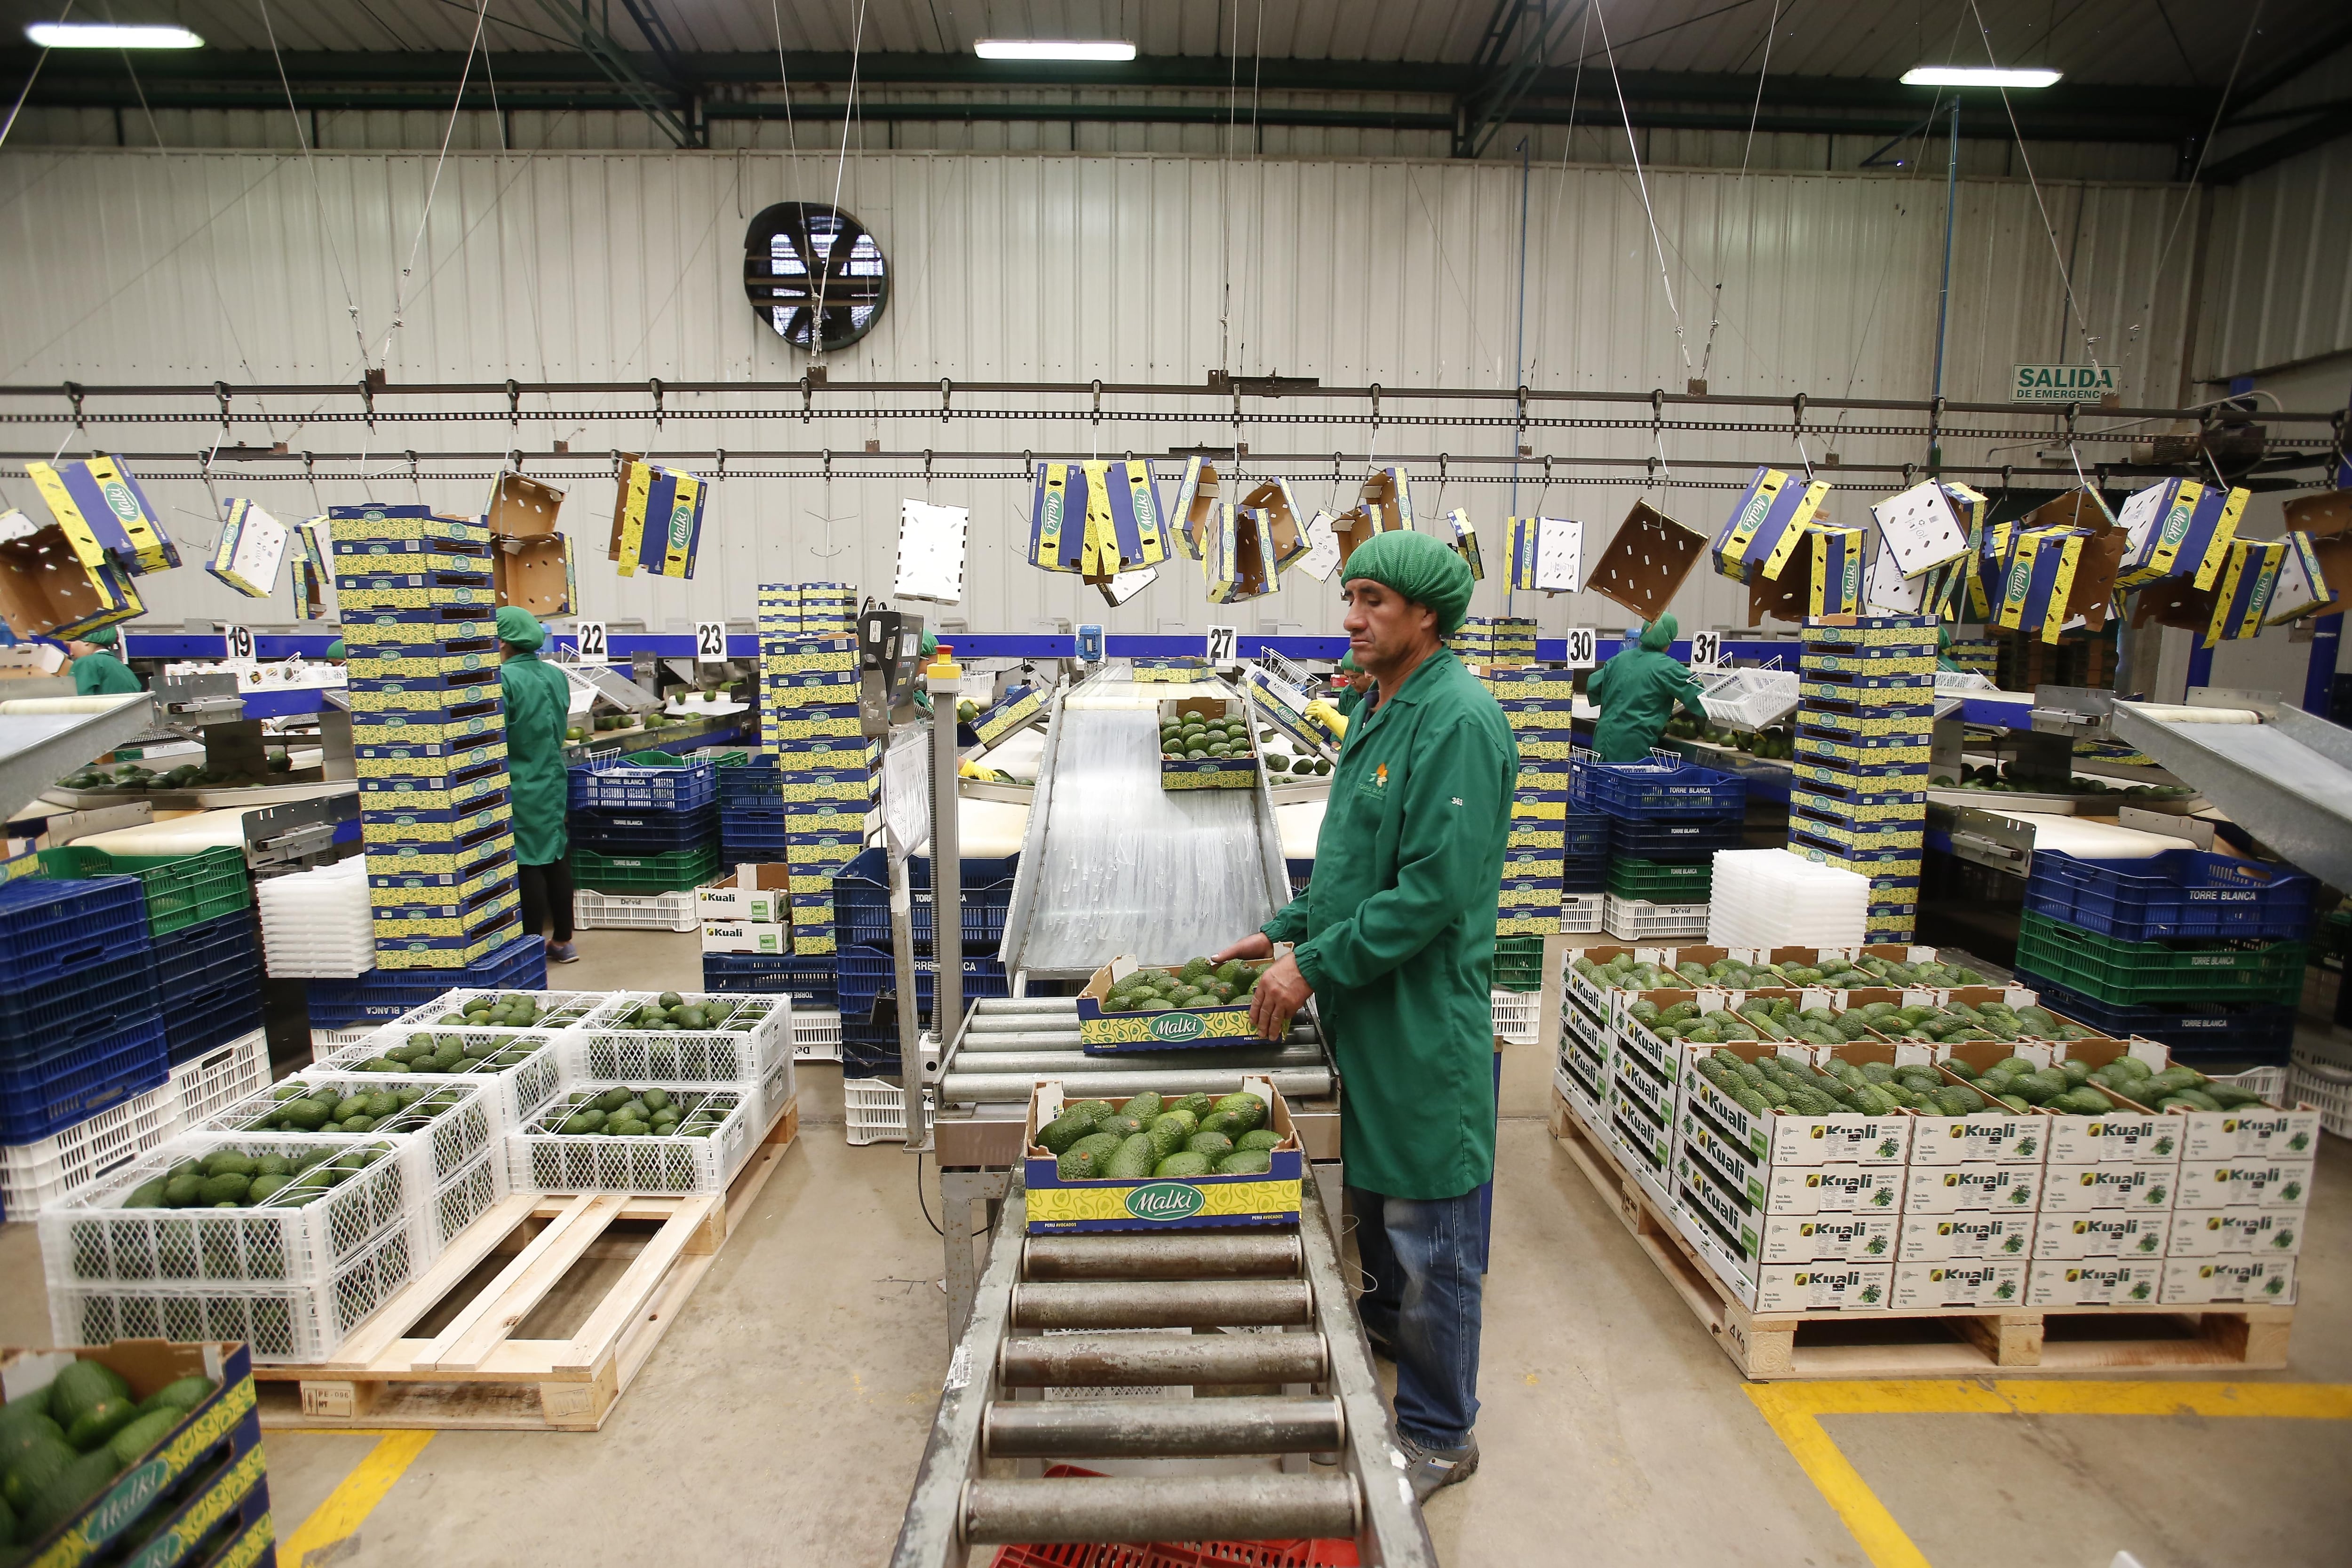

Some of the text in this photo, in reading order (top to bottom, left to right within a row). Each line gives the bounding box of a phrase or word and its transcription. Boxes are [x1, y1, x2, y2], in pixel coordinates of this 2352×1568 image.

[2018, 368, 2112, 388] SALIDA
[107, 487, 137, 517] Malki
[1047, 495, 1059, 531] Malki
[1136, 493, 1152, 527] Malki
[1744, 497, 1766, 529] Malki
[228, 525, 236, 543] Malki
[673, 511, 688, 545] Malki
[2165, 509, 2186, 541] Malki
[1524, 541, 1532, 568] Malki
[1846, 565, 1855, 596] Malki
[2011, 564, 2027, 598] Malki
[2253, 577, 2268, 608] Malki
[230, 626, 250, 656] 19
[580, 625, 603, 654] 22
[699, 624, 722, 654] 23
[1211, 629, 1233, 658] 27
[1570, 631, 1591, 661] 30
[1694, 634, 1716, 662] 31
[1278, 708, 1296, 722] Malki
[1199, 765, 1217, 773] Malki
[2190, 891, 2256, 900] TORRE BLANCA
[2211, 957, 2234, 965] BLANCA
[1577, 981, 1598, 1009] Kuali
[1155, 1018, 1197, 1036] Malki
[1576, 1017, 1597, 1045] Kuali
[1634, 1027, 1662, 1063] Kuali
[1574, 1051, 1596, 1082] Kuali
[1630, 1067, 1659, 1105] Kuali
[1627, 1106, 1654, 1145] Kuali
[1708, 1089, 1747, 1136] Kuali
[1965, 1123, 2015, 1138] Kuali
[2103, 1122, 2153, 1137] Kuali
[1706, 1135, 1744, 1183] Kuali
[1821, 1174, 1872, 1188] Kuali
[1959, 1172, 2009, 1186] Kuali
[2095, 1172, 2145, 1186] Kuali
[2230, 1168, 2280, 1182] Kuali
[1134, 1189, 1193, 1213] Malki
[1702, 1177, 1739, 1230] Kuali
[1815, 1222, 1866, 1235] Kuali
[1953, 1221, 2002, 1234] Kuali
[2088, 1220, 2137, 1234] Kuali
[1810, 1272, 1859, 1285] Kuali
[1945, 1267, 1994, 1281] Kuali
